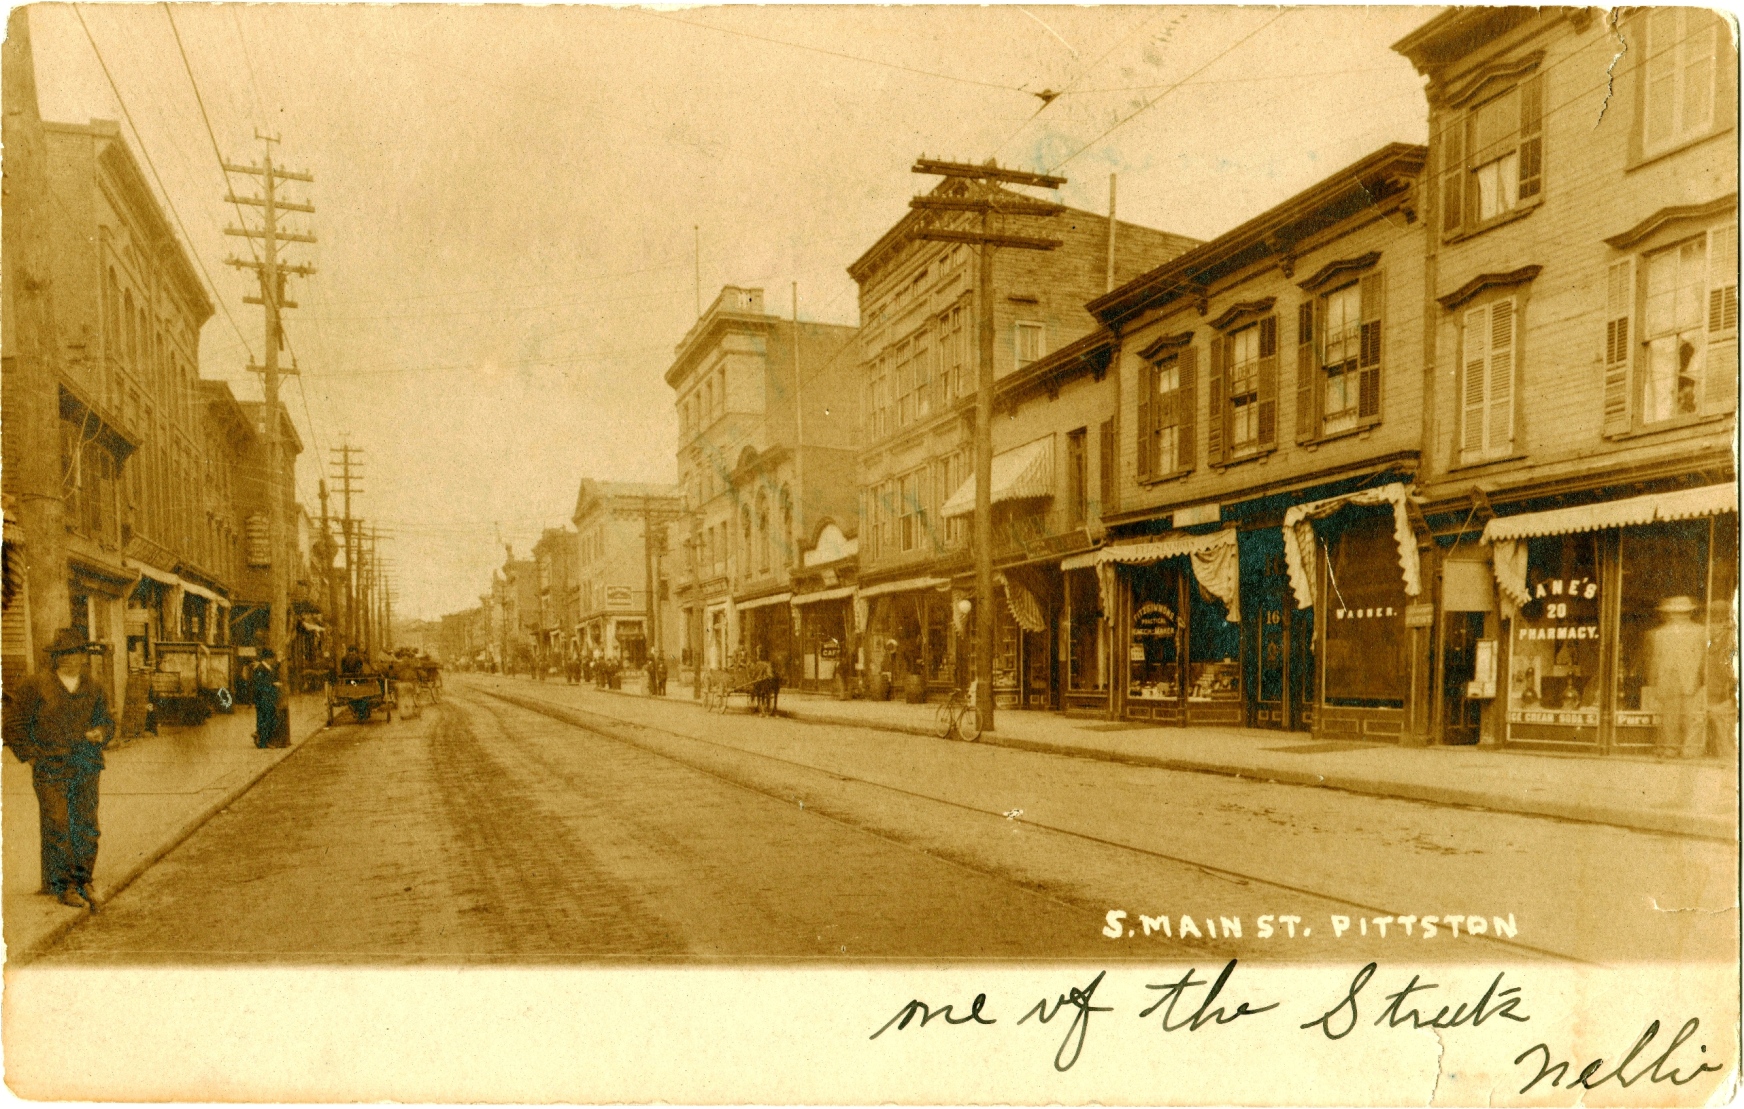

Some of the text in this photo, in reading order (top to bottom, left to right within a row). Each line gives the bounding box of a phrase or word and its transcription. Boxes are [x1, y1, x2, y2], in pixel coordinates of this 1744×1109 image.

[1266, 609, 1281, 624] 16
[1547, 603, 1567, 618] 20
[1519, 626, 1600, 640] PHARMACY.
[1525, 712, 1555, 724] CREAM
[1558, 713, 1584, 725] SODA
[1017, 970, 1114, 1072] of
[1140, 959, 1281, 1032] the
